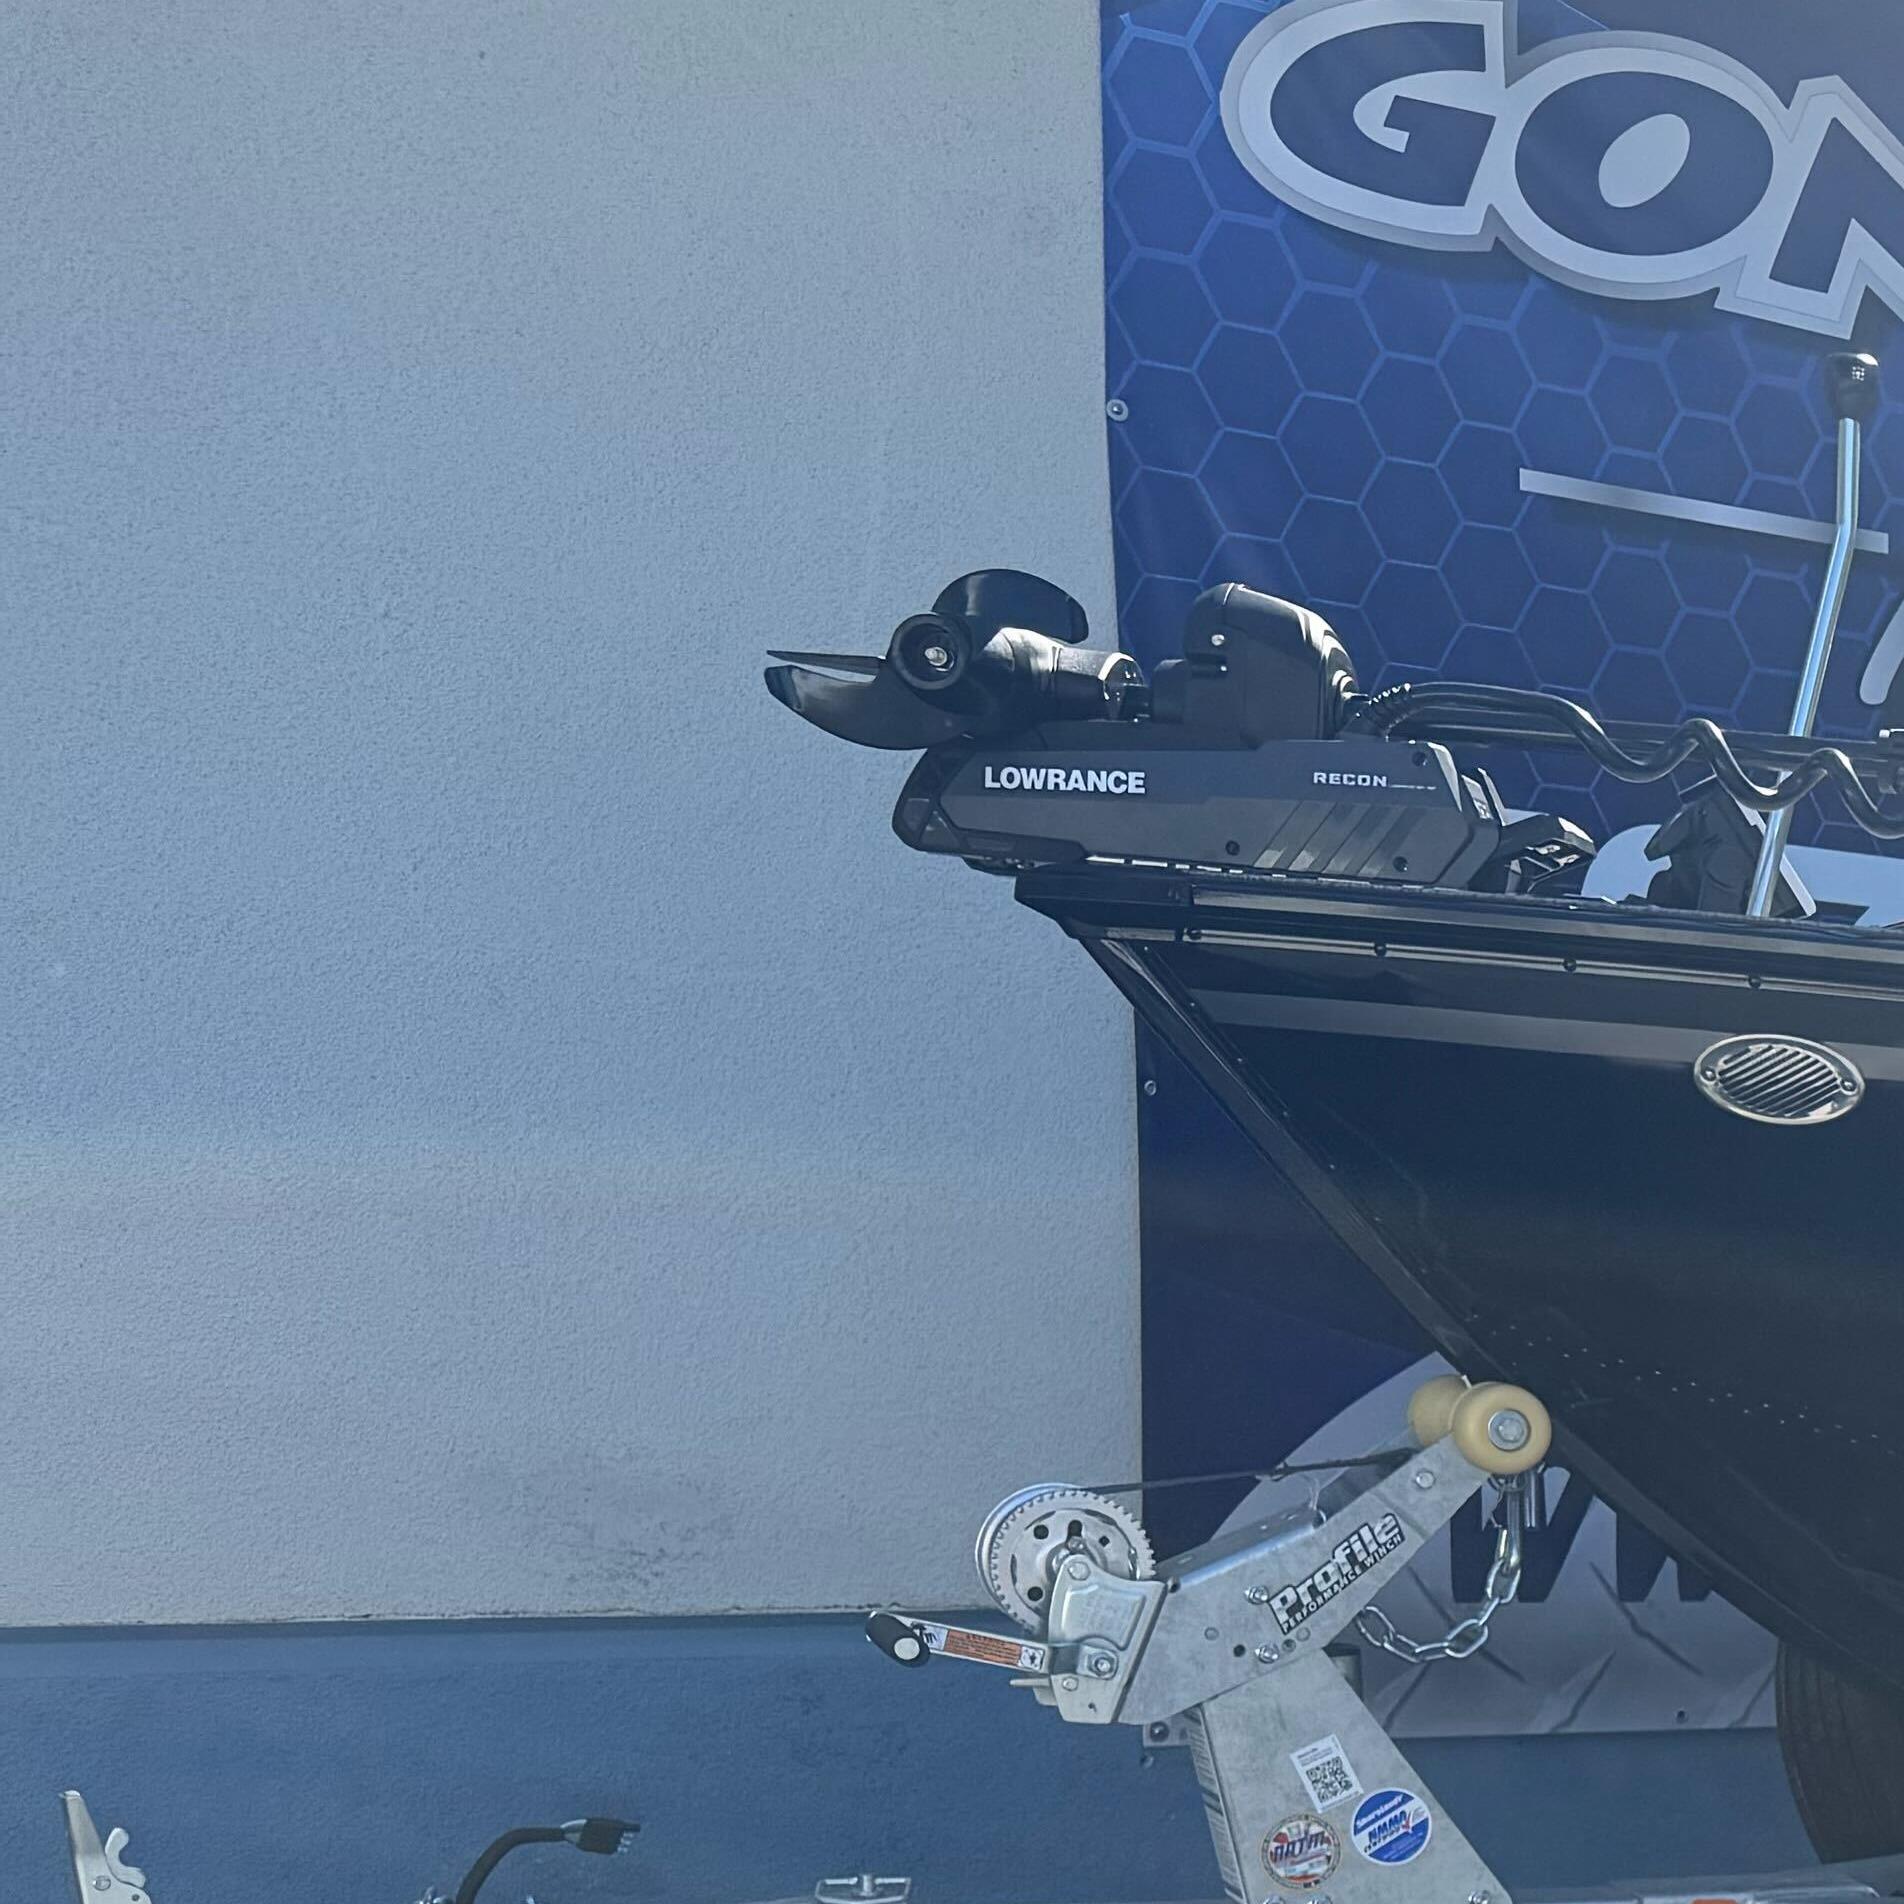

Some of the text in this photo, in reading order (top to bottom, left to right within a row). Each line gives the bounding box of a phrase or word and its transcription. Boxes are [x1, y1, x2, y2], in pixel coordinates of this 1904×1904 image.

[984, 766, 1146, 794] LOWRANCE
[1313, 771, 1388, 788] RECON
[1268, 1513, 1402, 1625] Profile
[1283, 1532, 1403, 1633] PERFORMANCE WINCH
